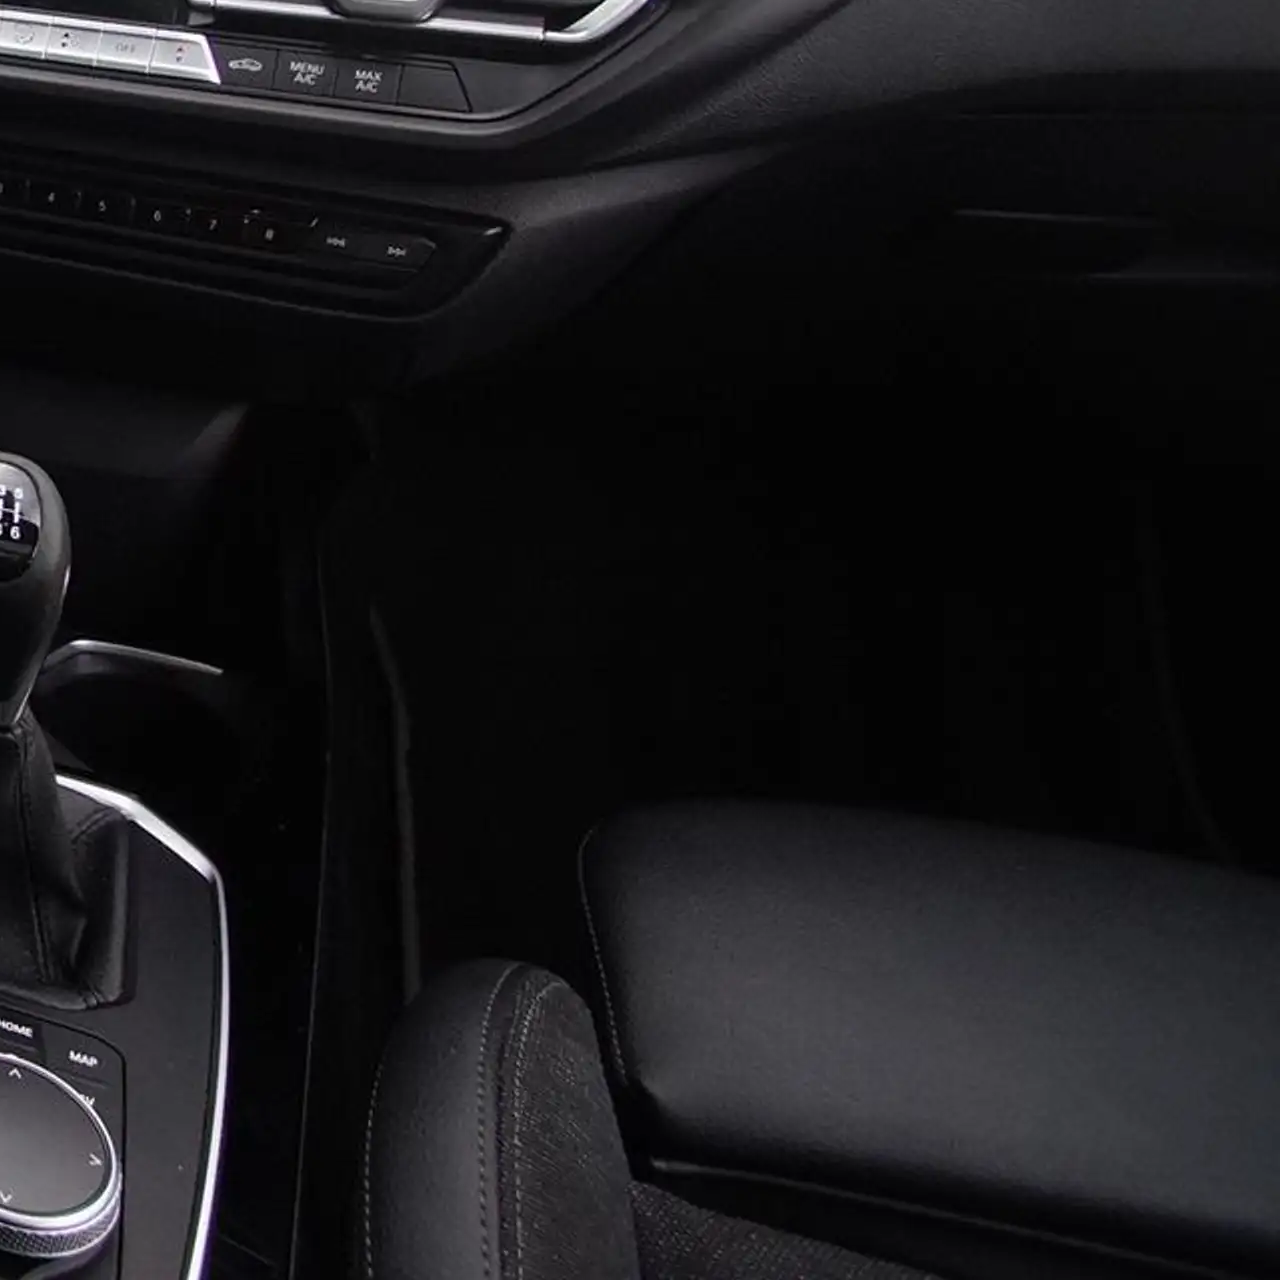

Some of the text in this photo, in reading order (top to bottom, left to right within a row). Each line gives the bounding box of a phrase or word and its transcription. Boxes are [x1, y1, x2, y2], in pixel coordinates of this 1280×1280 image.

[290, 61, 325, 76] MENU
[355, 70, 383, 81] MAX
[354, 80, 378, 93] A/C
[10, 526, 21, 540] 6
[68, 1050, 99, 1068] MAP
